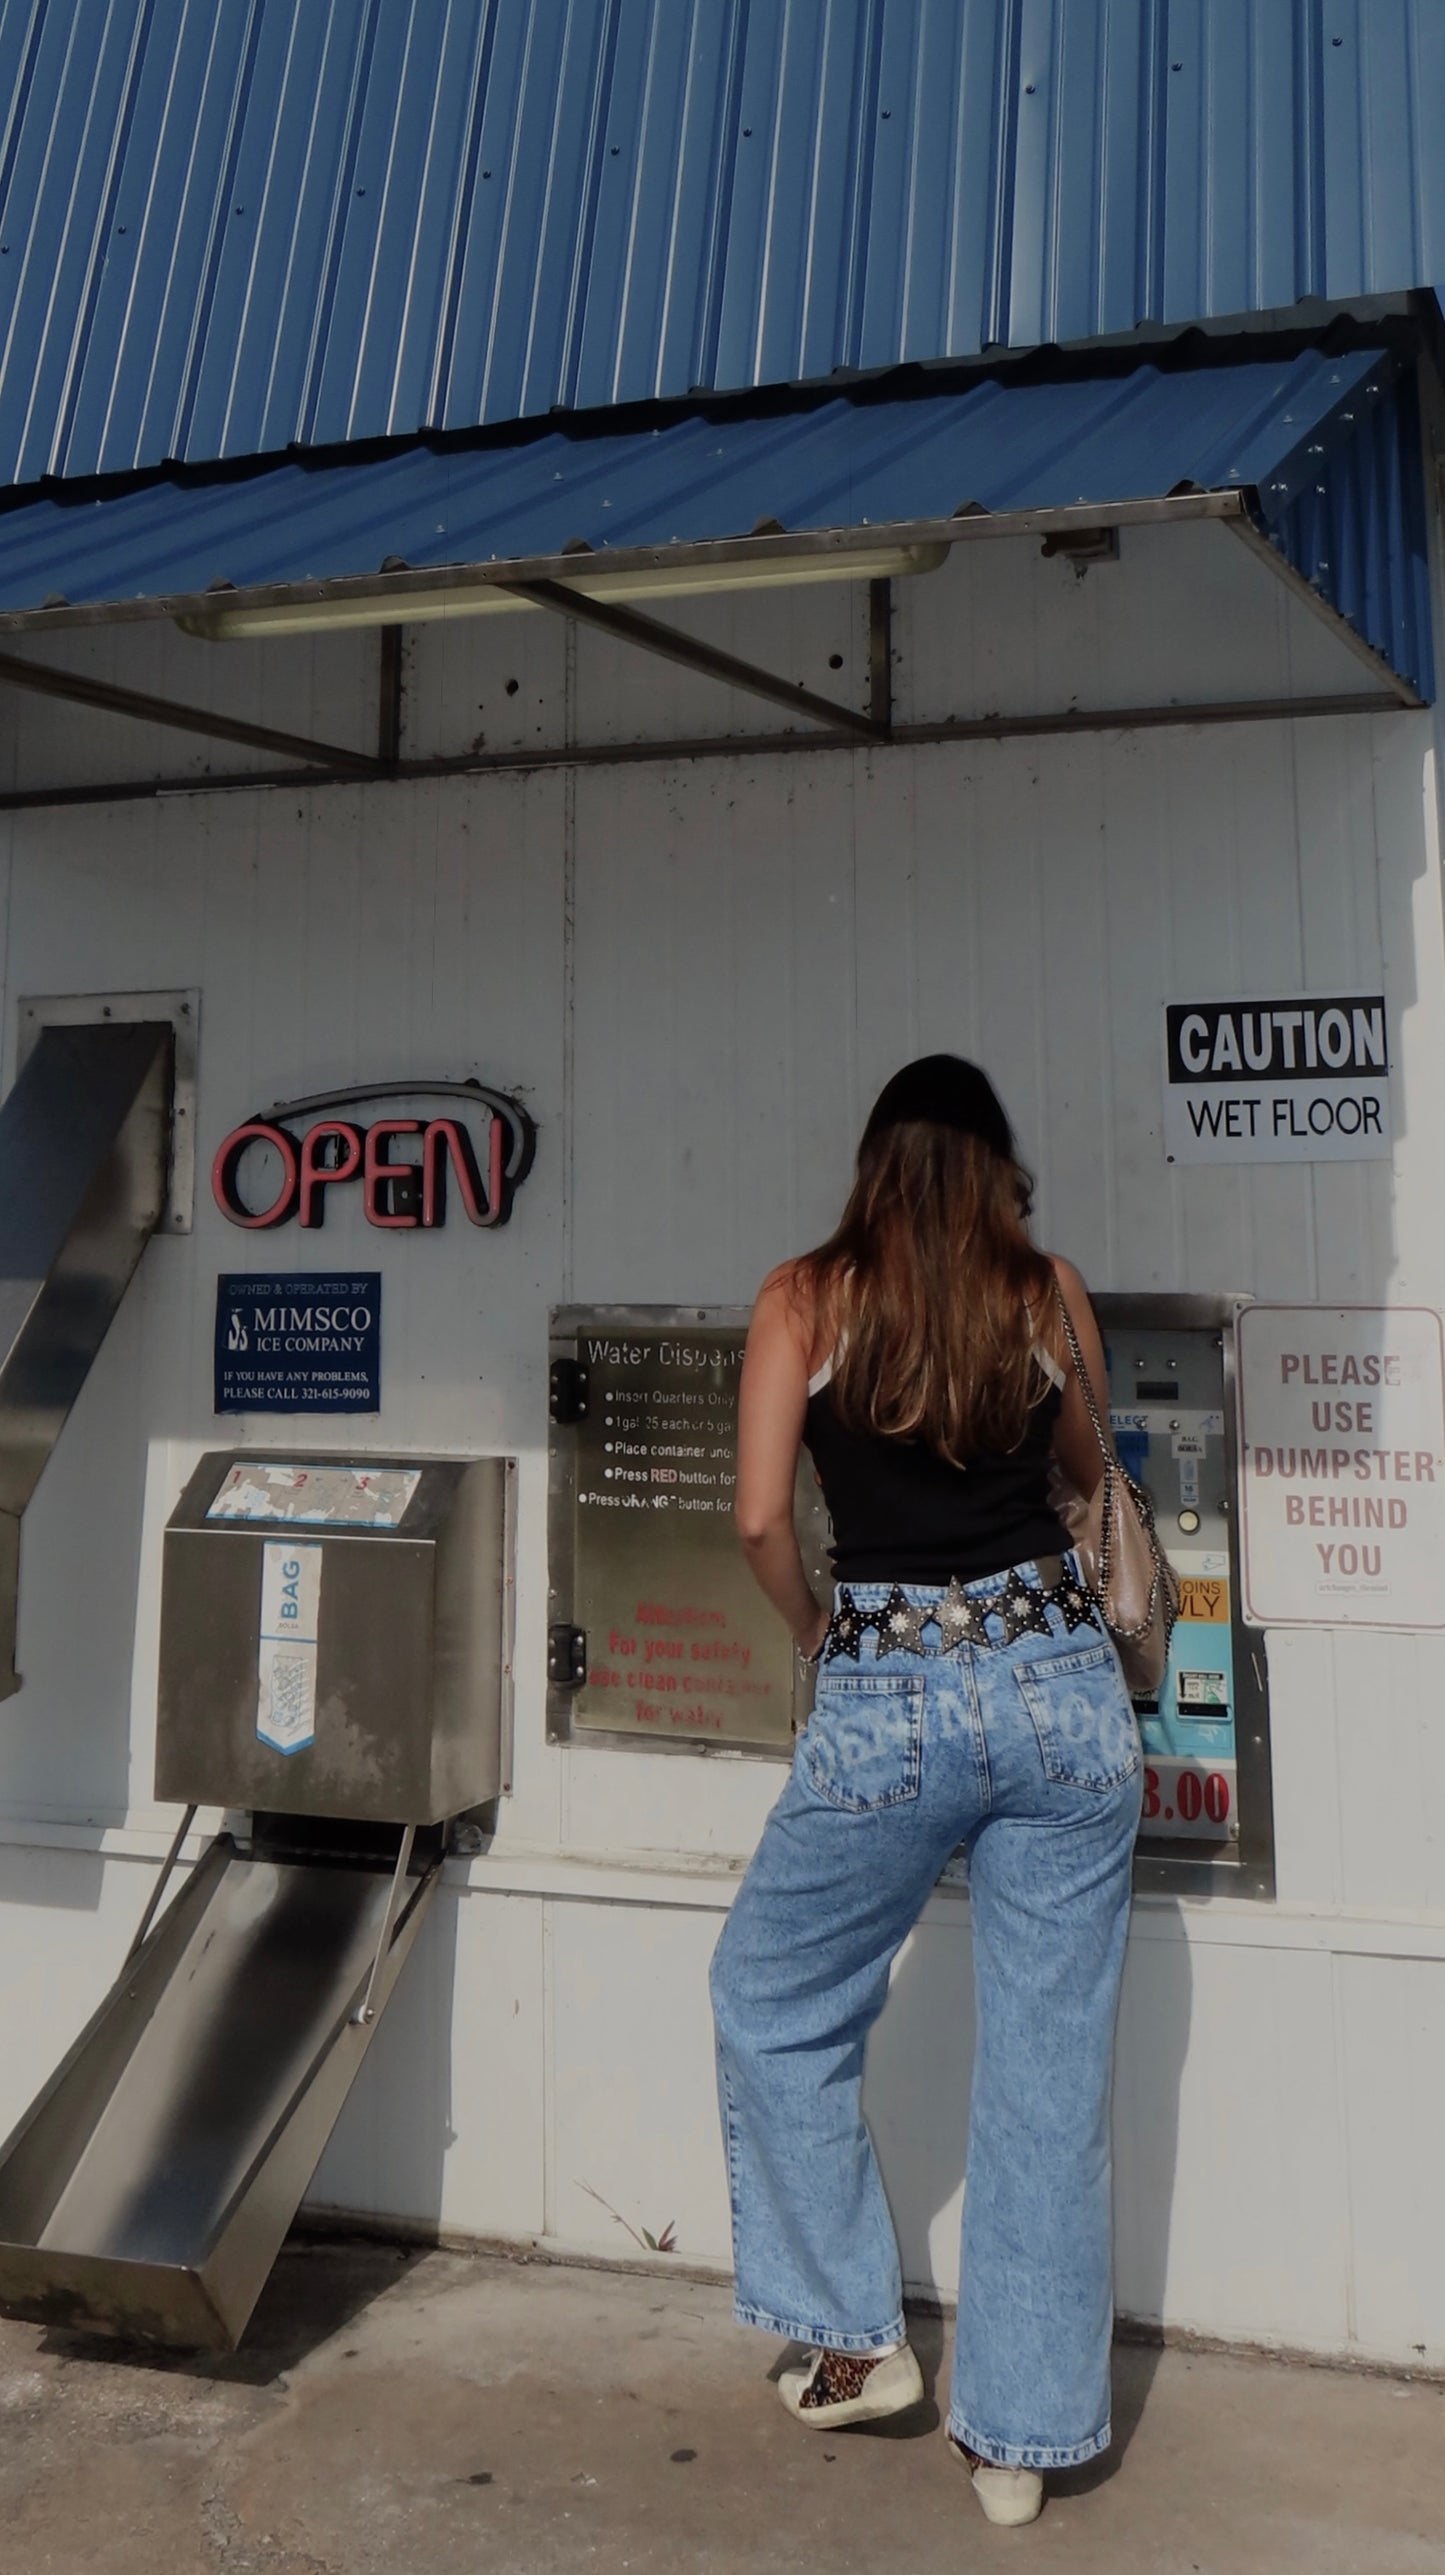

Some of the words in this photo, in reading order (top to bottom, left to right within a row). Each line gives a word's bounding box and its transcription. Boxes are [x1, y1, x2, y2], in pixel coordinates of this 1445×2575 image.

[1179, 1008, 1385, 1073] CAUTION
[1187, 1100, 1261, 1138] WET
[1273, 1097, 1383, 1136] FLOOR
[211, 1117, 502, 1229] OPEN
[229, 1284, 271, 1295] OWNED
[273, 1284, 283, 1295] &
[286, 1283, 349, 1295] OPERATED
[351, 1282, 368, 1294] BY
[254, 1307, 371, 1331] MIMSCO
[257, 1337, 281, 1351] ICE
[285, 1337, 365, 1351] COMPANY
[588, 1340, 651, 1365] Water
[224, 1371, 233, 1381] IF
[236, 1371, 255, 1381] YOU
[257, 1371, 283, 1381] HAVE
[286, 1371, 308, 1381] ANY
[311, 1371, 369, 1382] PROBLEMS,
[1281, 1354, 1401, 1386] PLEASE
[224, 1388, 264, 1399] PLEASE
[267, 1388, 299, 1399] CALL
[301, 1388, 370, 1399] 321-615-9090
[615, 1390, 648, 1403] Insert
[652, 1391, 704, 1406] Quarters
[662, 1418, 690, 1431] each
[717, 1422, 733, 1435] ga
[1312, 1401, 1373, 1433] USE
[615, 1441, 647, 1455] Place
[651, 1445, 705, 1458] container
[1254, 1446, 1436, 1482] DUMPSTER
[232, 1470, 242, 1484] 1
[294, 1474, 308, 1488] 2
[356, 1476, 371, 1490] 3
[615, 1467, 648, 1482] Press
[650, 1468, 678, 1483] RED
[679, 1471, 717, 1485] button
[720, 1472, 736, 1486] for
[588, 1492, 620, 1507] Press
[621, 1494, 676, 1508] ORANG
[678, 1497, 714, 1511] button
[716, 1498, 732, 1512] for
[1285, 1495, 1407, 1529] BEHIND
[1316, 1543, 1382, 1577] YOU
[281, 1560, 300, 1619] BAG
[1179, 1580, 1221, 1595] OINS
[609, 1629, 637, 1656] For
[644, 1639, 684, 1663] your
[627, 1670, 677, 1692] clean
